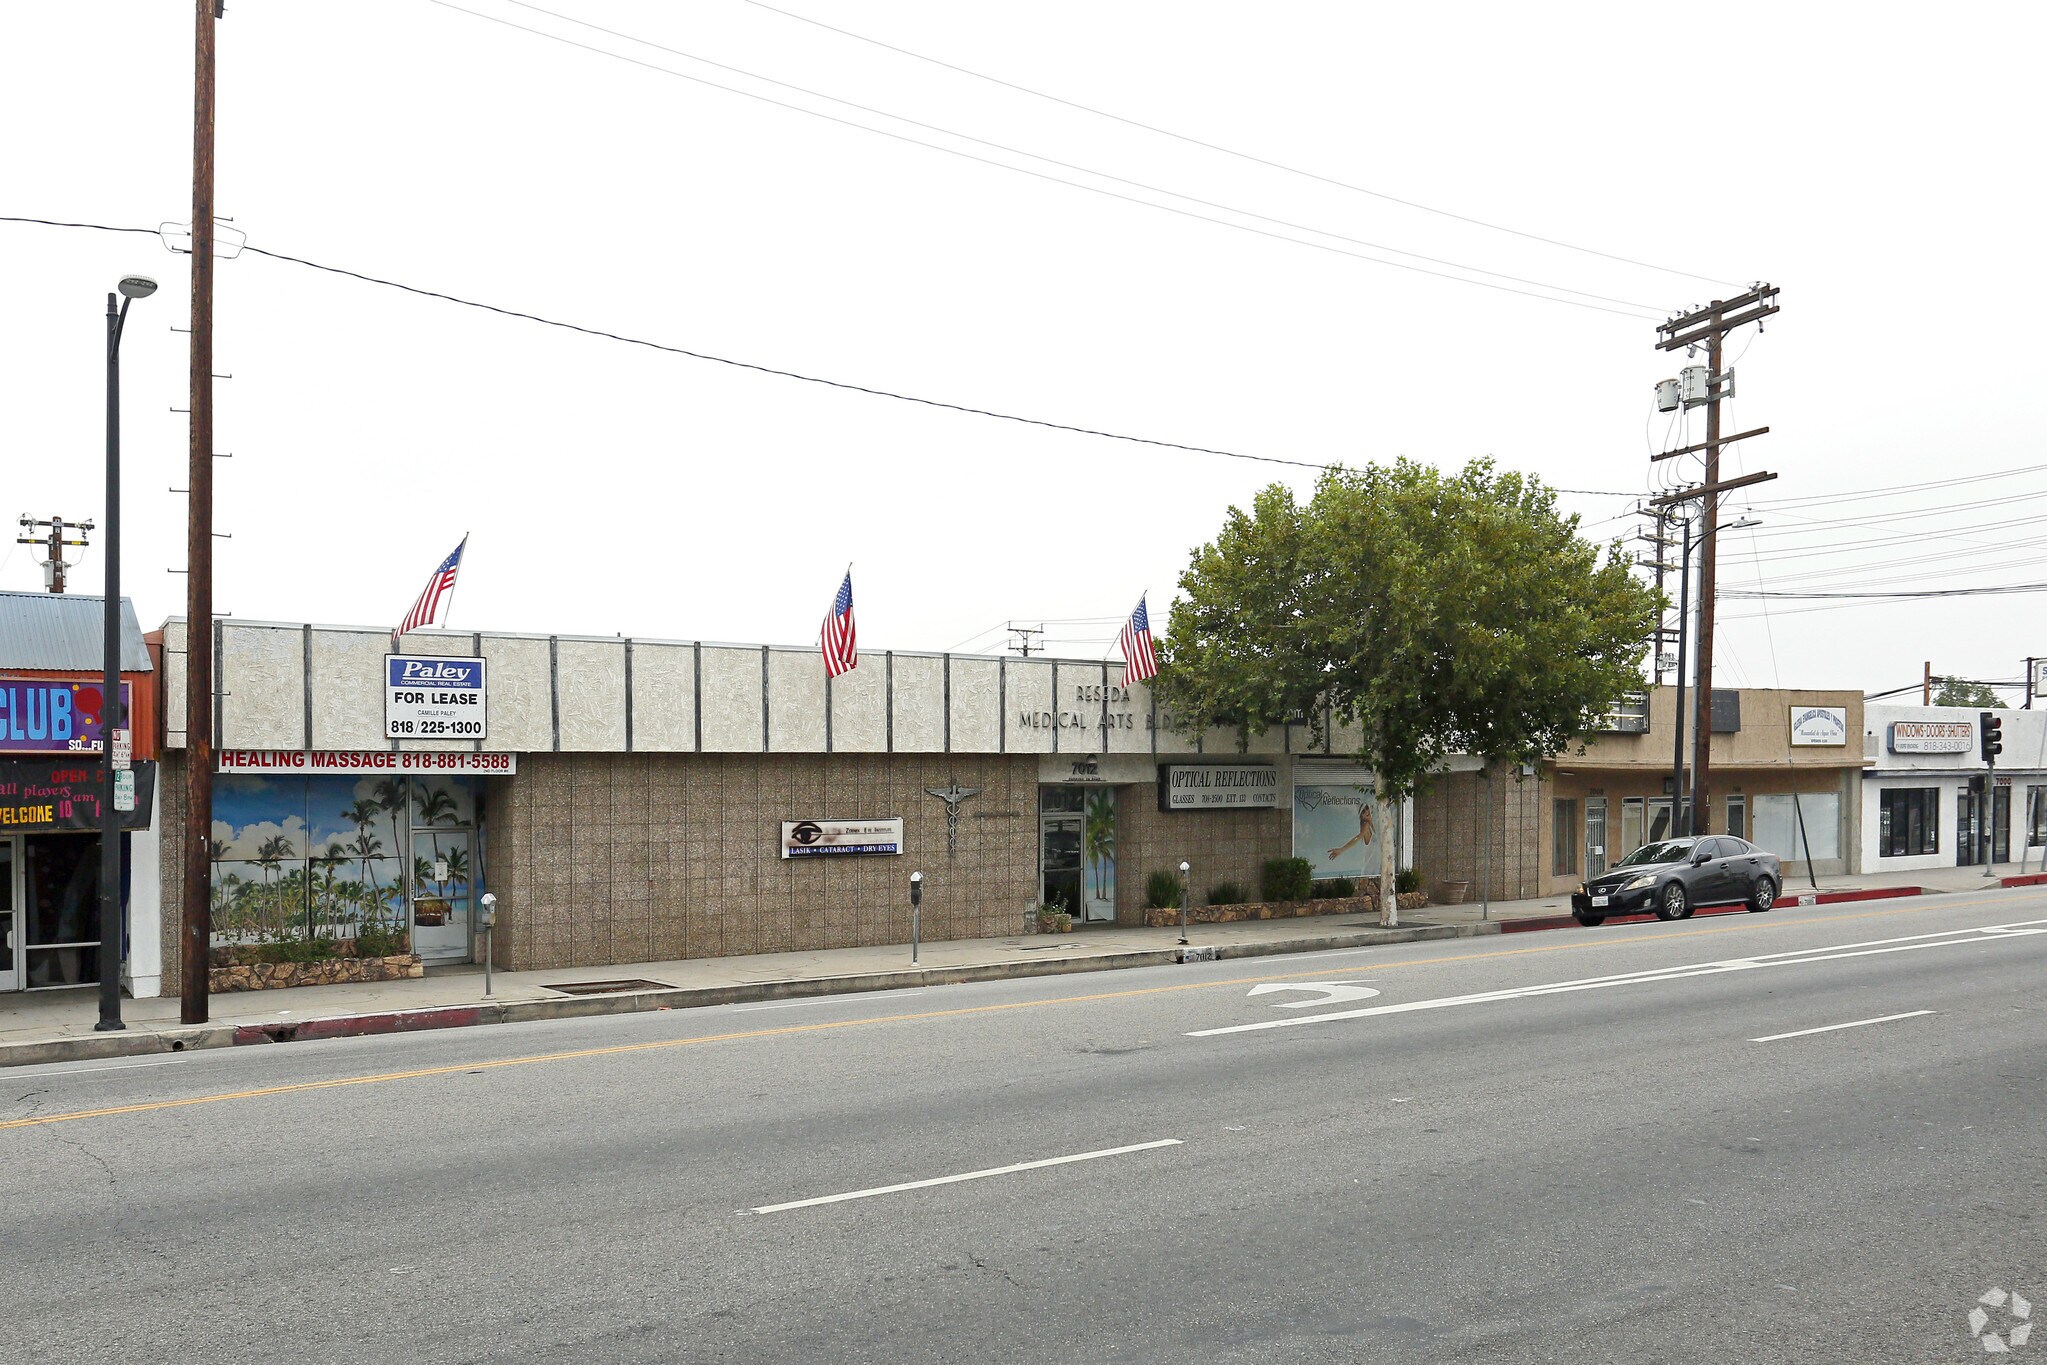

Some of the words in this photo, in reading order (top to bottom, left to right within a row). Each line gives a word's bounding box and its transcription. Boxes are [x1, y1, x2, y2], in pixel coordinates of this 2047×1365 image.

[402, 661, 471, 681] Paley
[394, 692, 425, 704] FOR
[431, 693, 478, 705] LEASE
[1076, 685, 1130, 702] RESEDA
[391, 720, 481, 734] 818/225-1300
[1019, 711, 1087, 729] MEDICAL
[1097, 713, 1134, 730] ARTS
[1896, 724, 1924, 738] WINDOWS
[1926, 724, 1945, 738] DOORS
[1947, 724, 1970, 738] SHUTTERS
[68, 739, 104, 751] SO...FU
[1924, 741, 1971, 751] 818-343-0016
[221, 751, 305, 768] HEALING
[311, 752, 397, 768] MASSAGE
[402, 753, 510, 769] 818-881-5588
[1071, 761, 1099, 776] 7012
[51, 769, 87, 783] OPEN
[1171, 770, 1212, 788] OPTICAL
[1214, 770, 1277, 788] REFLECTIONS
[1995, 777, 2012, 785] 7000
[0, 782, 18, 795] all
[24, 784, 72, 799] players
[73, 793, 95, 802] am
[1171, 794, 1195, 804] GLASSES
[1252, 793, 1277, 803] CONTACTS
[1322, 796, 1361, 806] Reflections
[0, 805, 53, 825] ELCOME
[791, 847, 811, 855] LASIK
[819, 845, 855, 853] CATARACT
